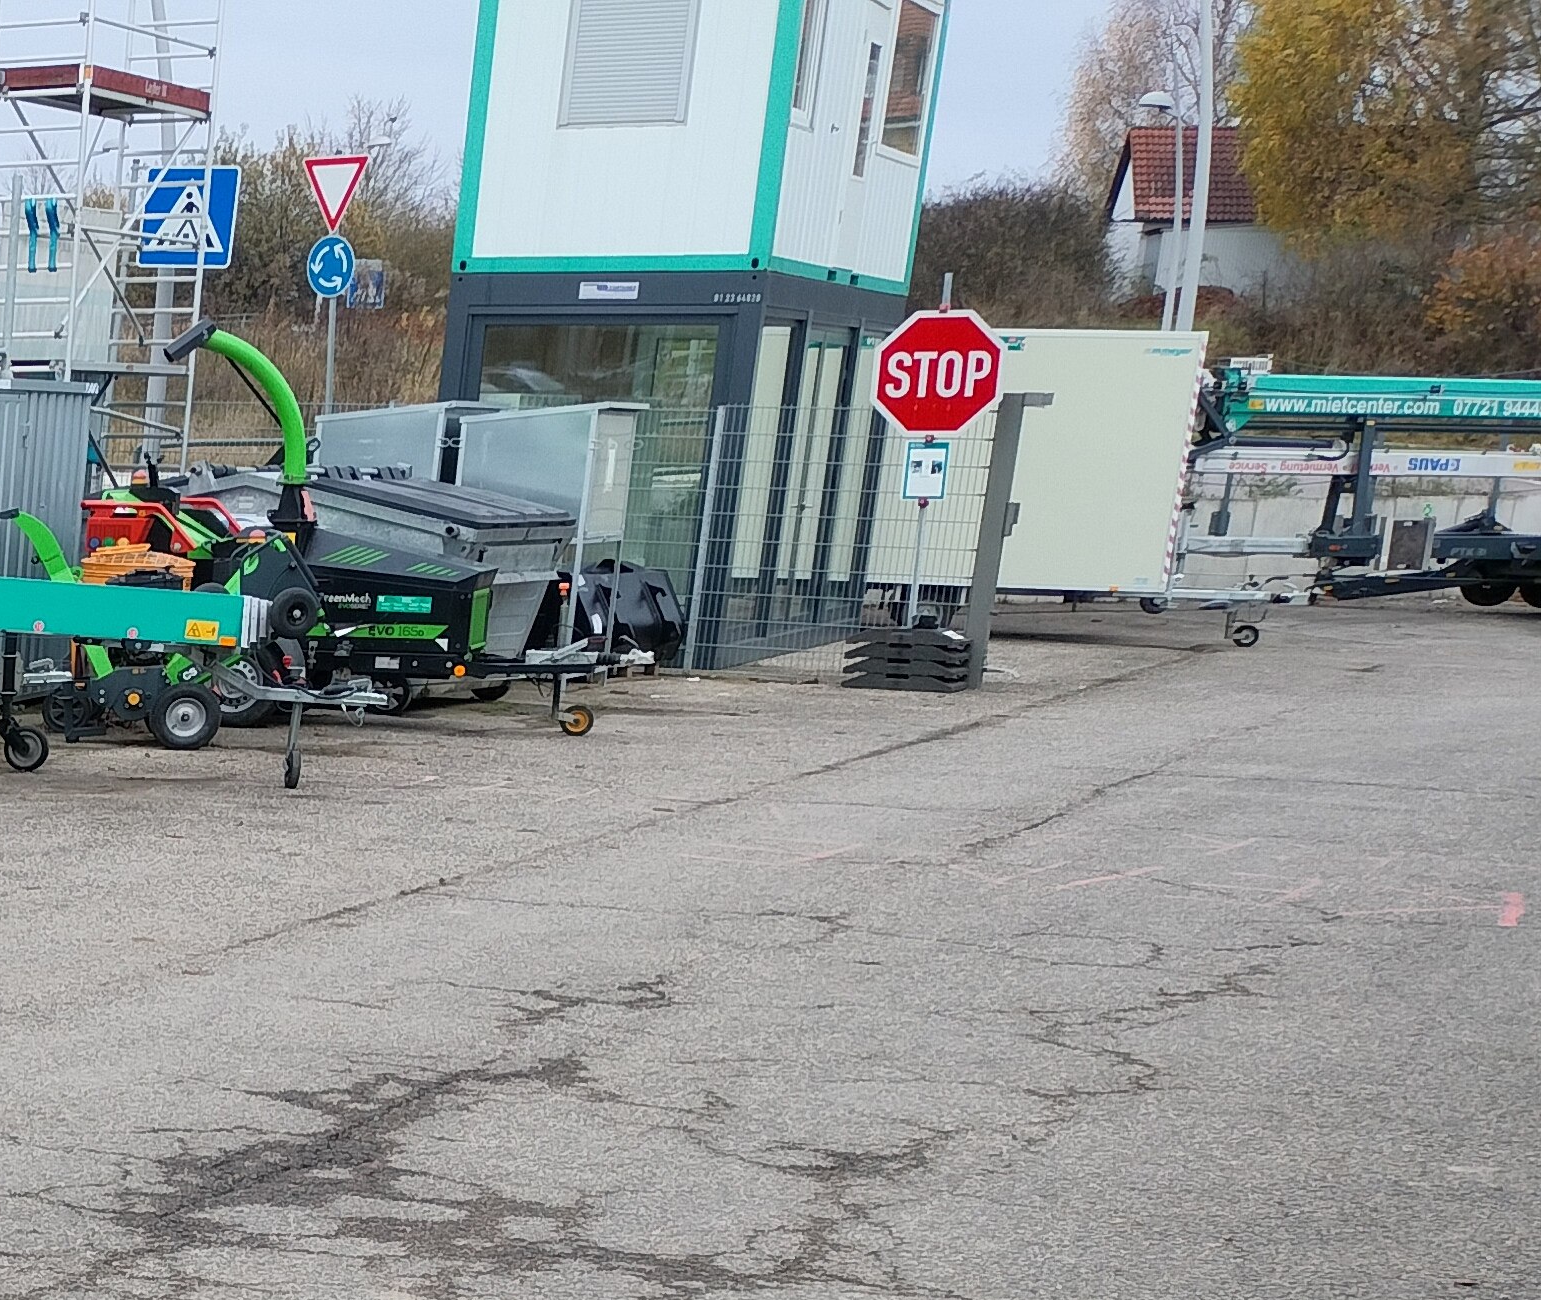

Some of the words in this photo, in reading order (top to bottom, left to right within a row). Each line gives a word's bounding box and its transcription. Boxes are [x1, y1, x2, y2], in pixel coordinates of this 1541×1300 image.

[884, 350, 993, 399] STOP
[1265, 396, 1441, 416] www.mietcenter.com
[1452, 399, 1498, 417] 07721
[368, 624, 395, 637] EVO
